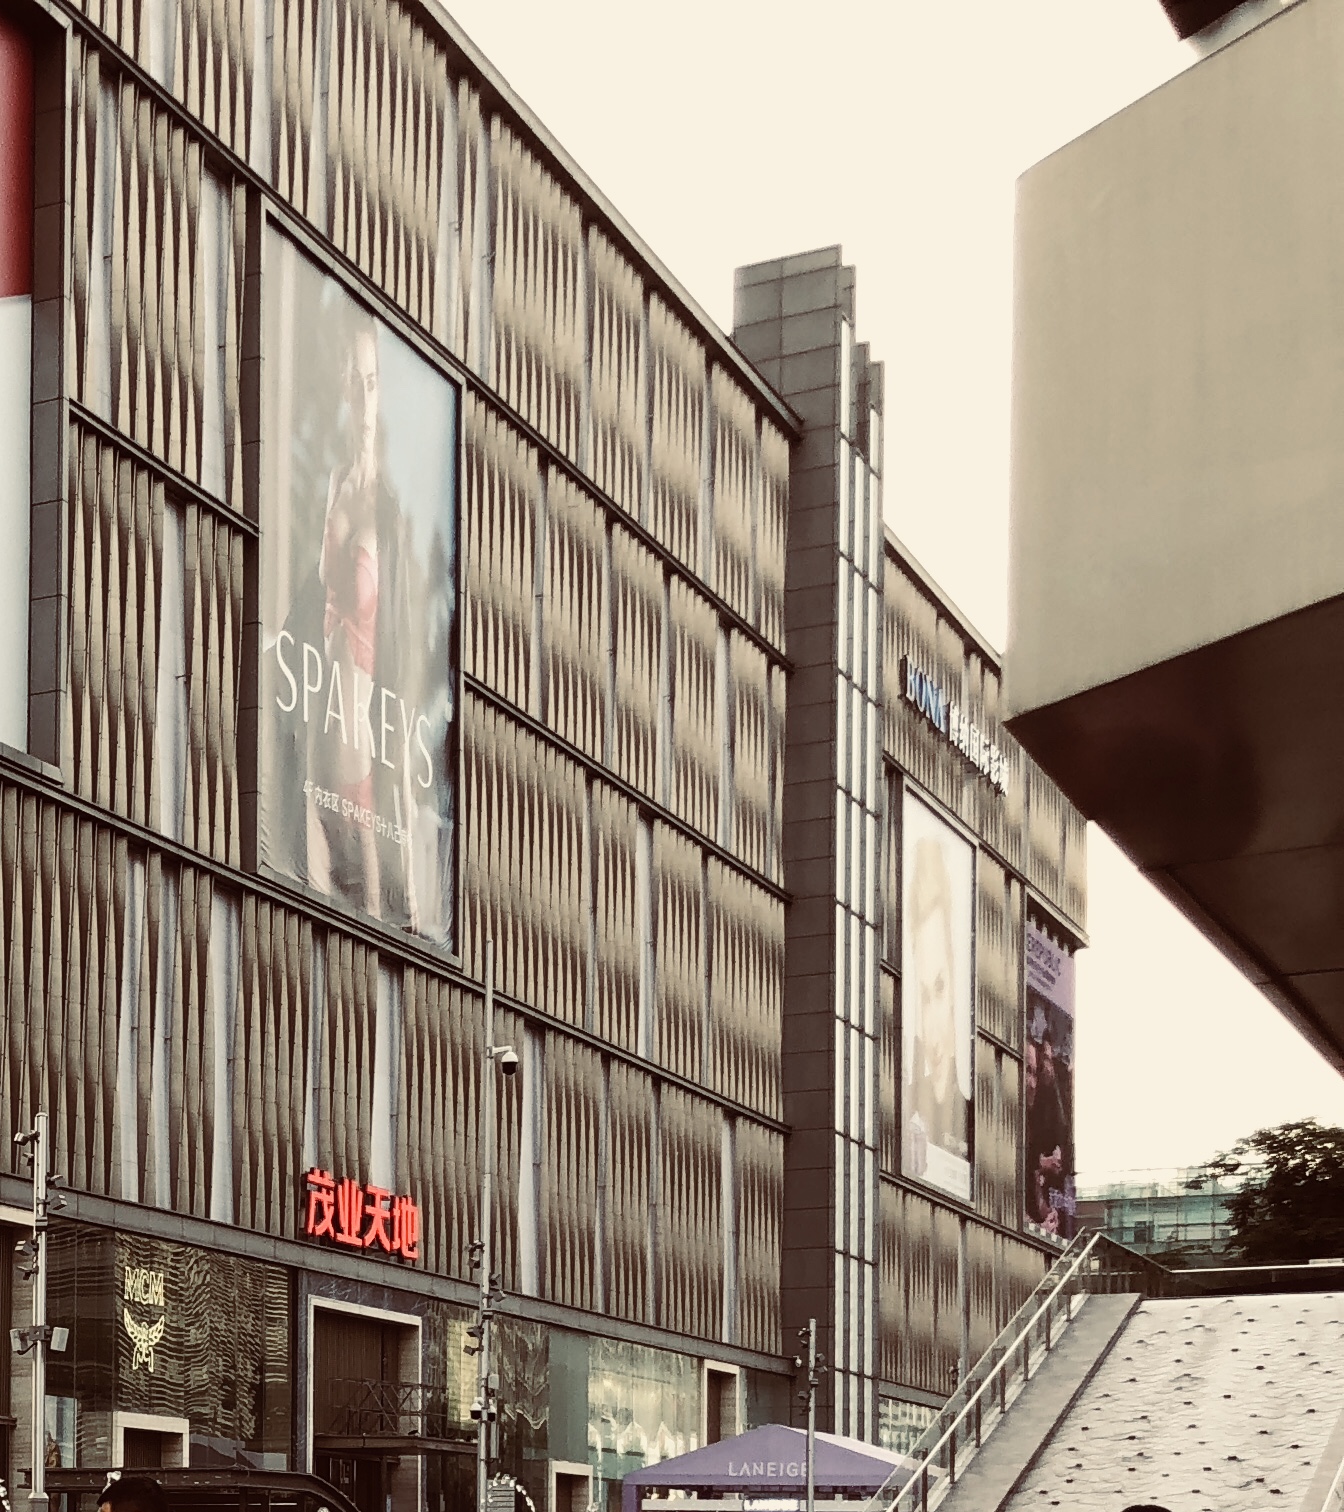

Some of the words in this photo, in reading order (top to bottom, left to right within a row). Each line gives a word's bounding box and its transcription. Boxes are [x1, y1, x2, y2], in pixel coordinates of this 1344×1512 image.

[276, 631, 433, 788] SPAKEYS
[307, 1168, 418, 1259] 茂业天地
[124, 1266, 164, 1306] MCM
[728, 1462, 807, 1477] LANEIGE
